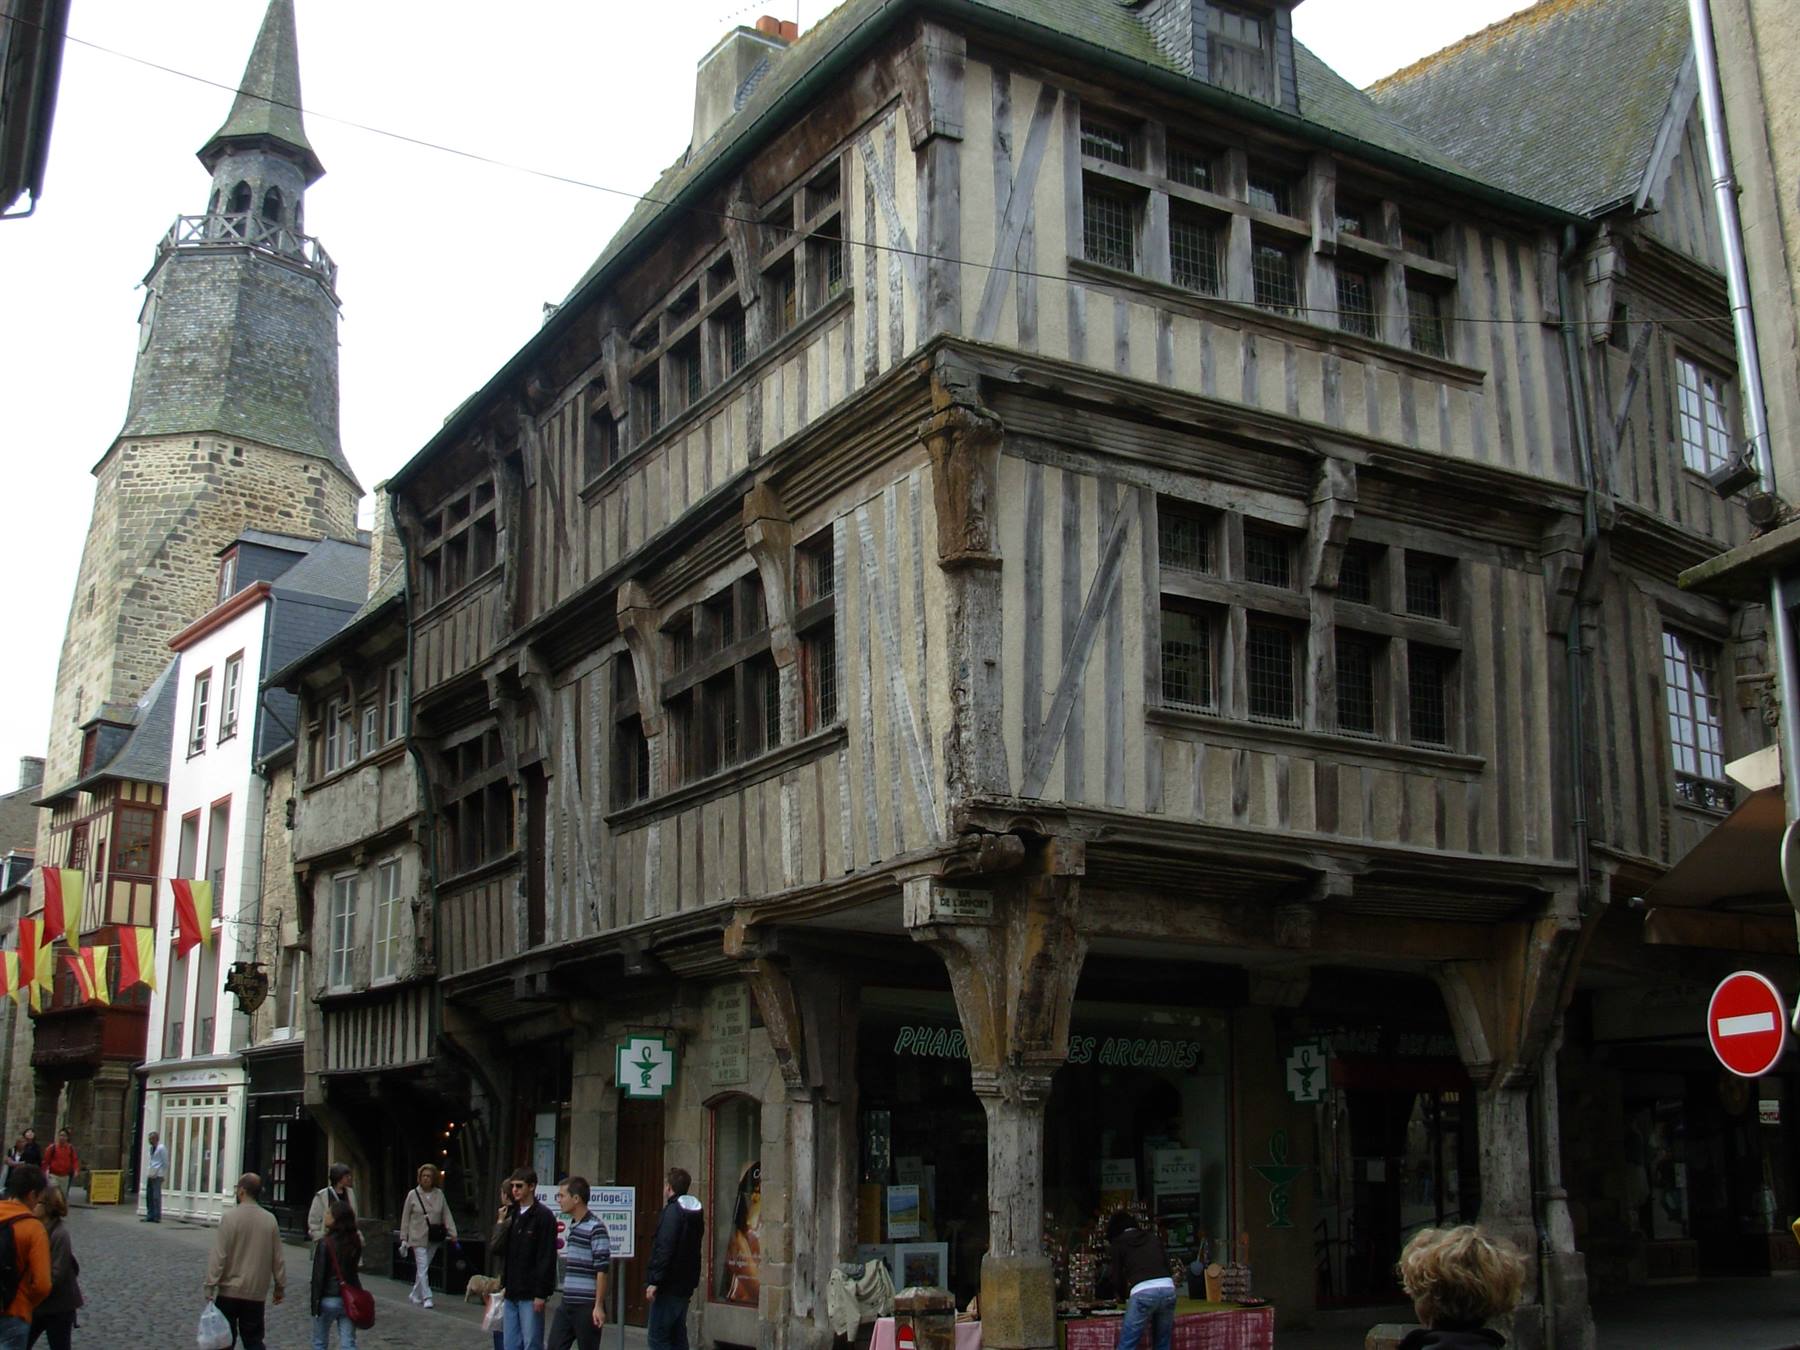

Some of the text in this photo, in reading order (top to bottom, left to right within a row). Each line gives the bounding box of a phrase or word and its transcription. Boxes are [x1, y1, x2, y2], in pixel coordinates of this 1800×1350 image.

[940, 897, 950, 908] DE
[893, 1025, 1201, 1068] PHAR ES ARCADES
[591, 1192, 621, 1205] orloge
